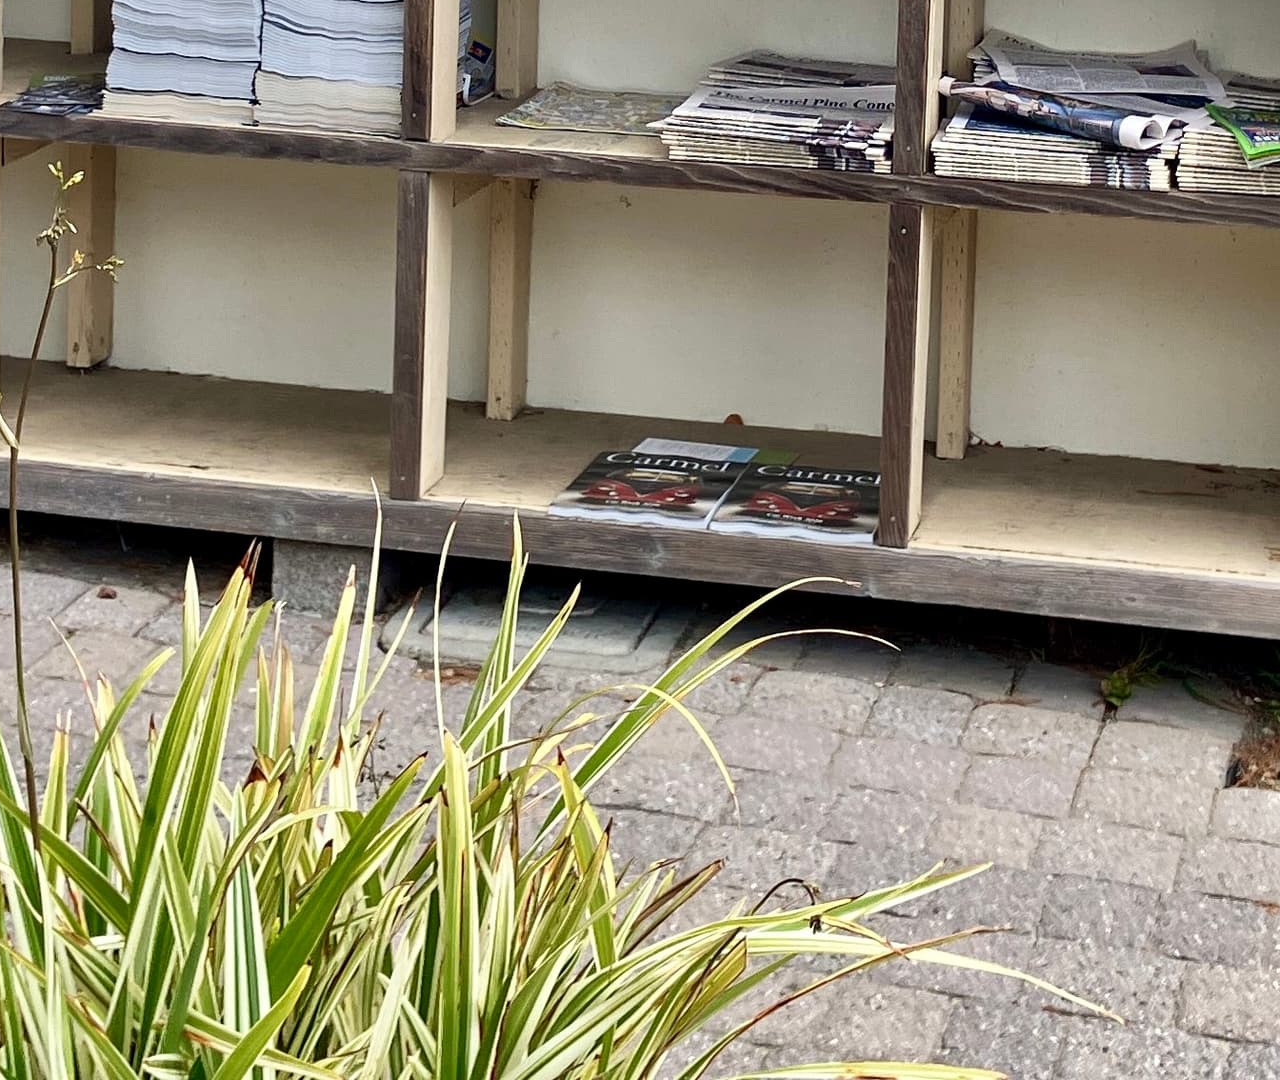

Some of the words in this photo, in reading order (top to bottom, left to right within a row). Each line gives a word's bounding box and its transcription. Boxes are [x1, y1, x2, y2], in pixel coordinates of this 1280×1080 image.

[813, 98, 848, 109] Pine
[853, 98, 896, 111] Cone
[606, 451, 732, 472] Carmel
[756, 464, 882, 486] Carmel
